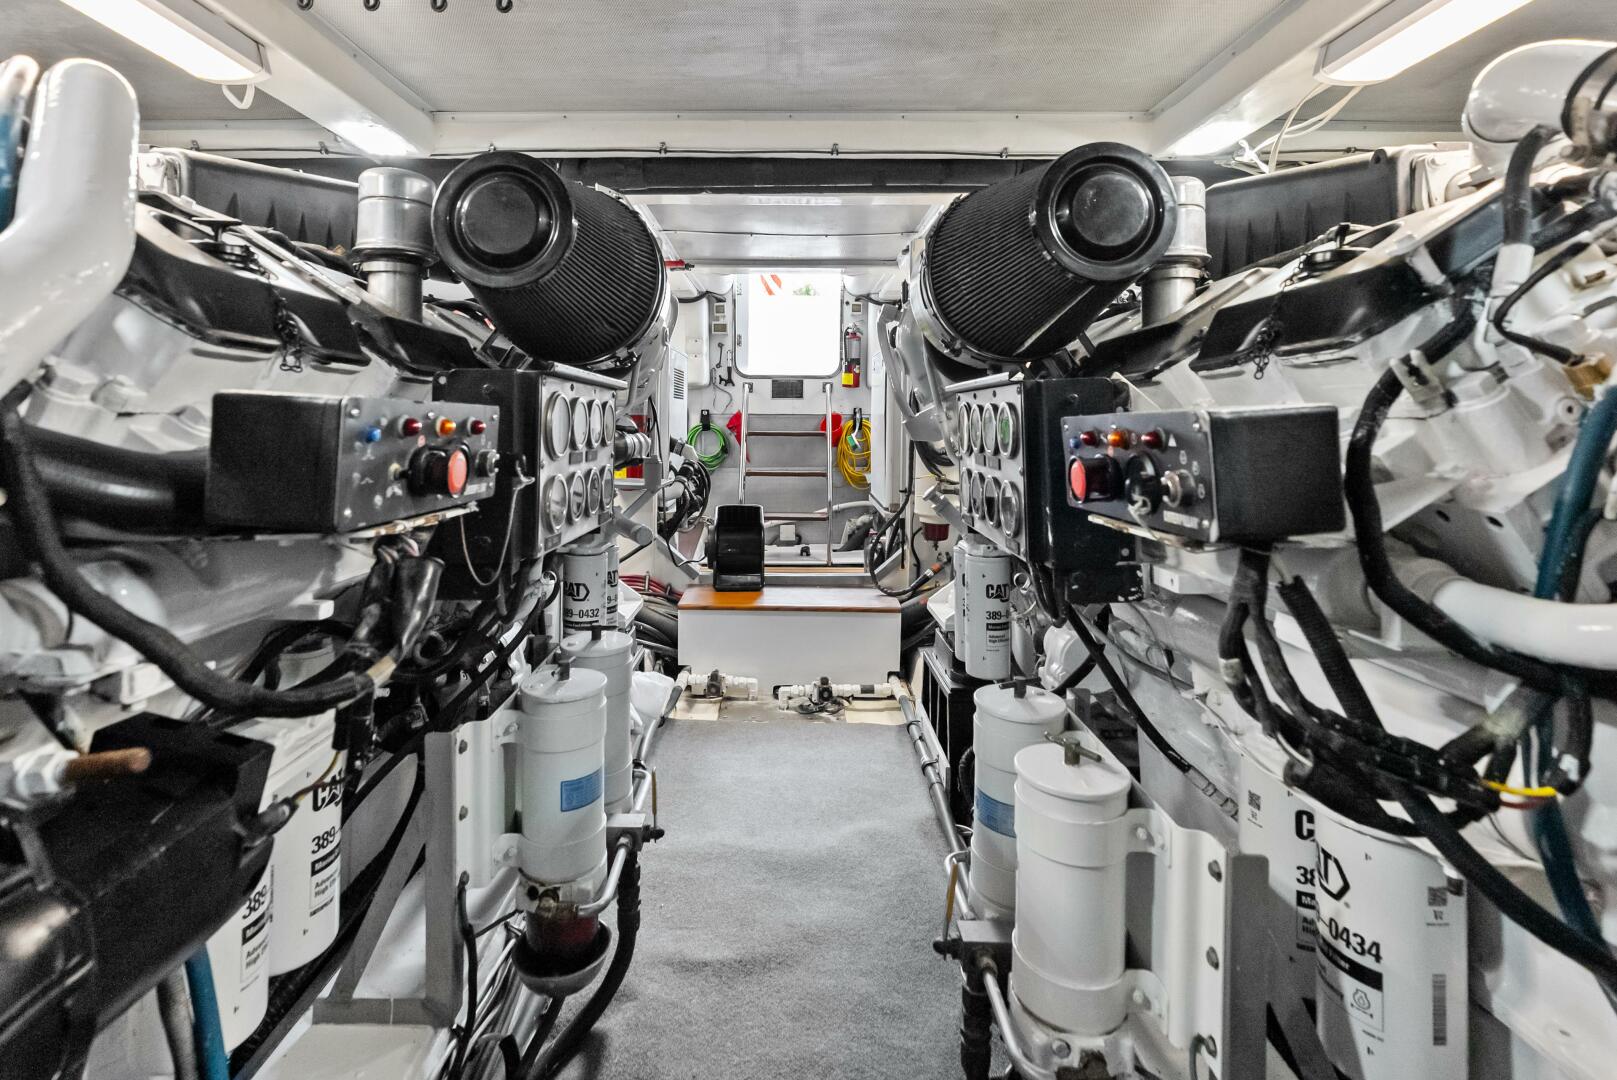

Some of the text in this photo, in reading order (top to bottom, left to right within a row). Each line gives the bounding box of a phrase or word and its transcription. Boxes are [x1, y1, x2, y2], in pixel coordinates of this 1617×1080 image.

[986, 584, 1009, 599] CAT
[564, 608, 599, 618] 9-0432
[1317, 909, 1382, 964] -0434
